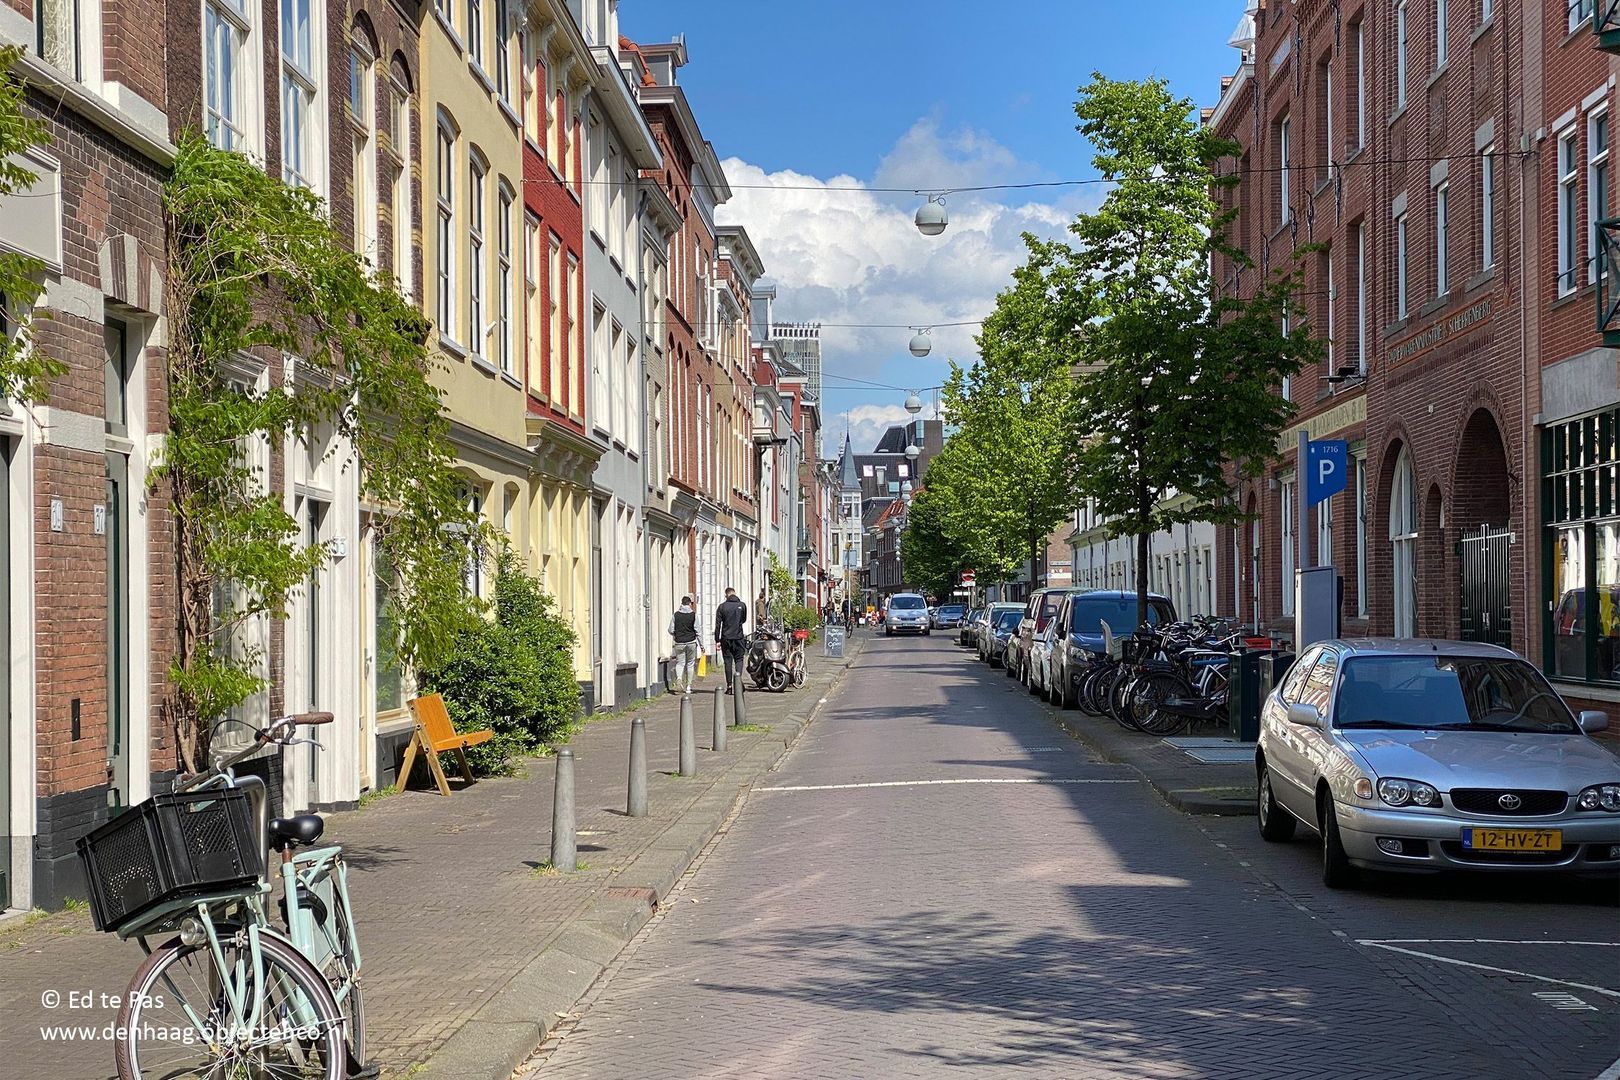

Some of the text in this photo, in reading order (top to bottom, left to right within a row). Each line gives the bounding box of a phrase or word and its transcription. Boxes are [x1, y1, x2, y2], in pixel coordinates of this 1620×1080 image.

[1322, 445, 1339, 454] 1716
[1319, 459, 1335, 485] P
[1481, 831, 1553, 848] 12-HV-ZT
